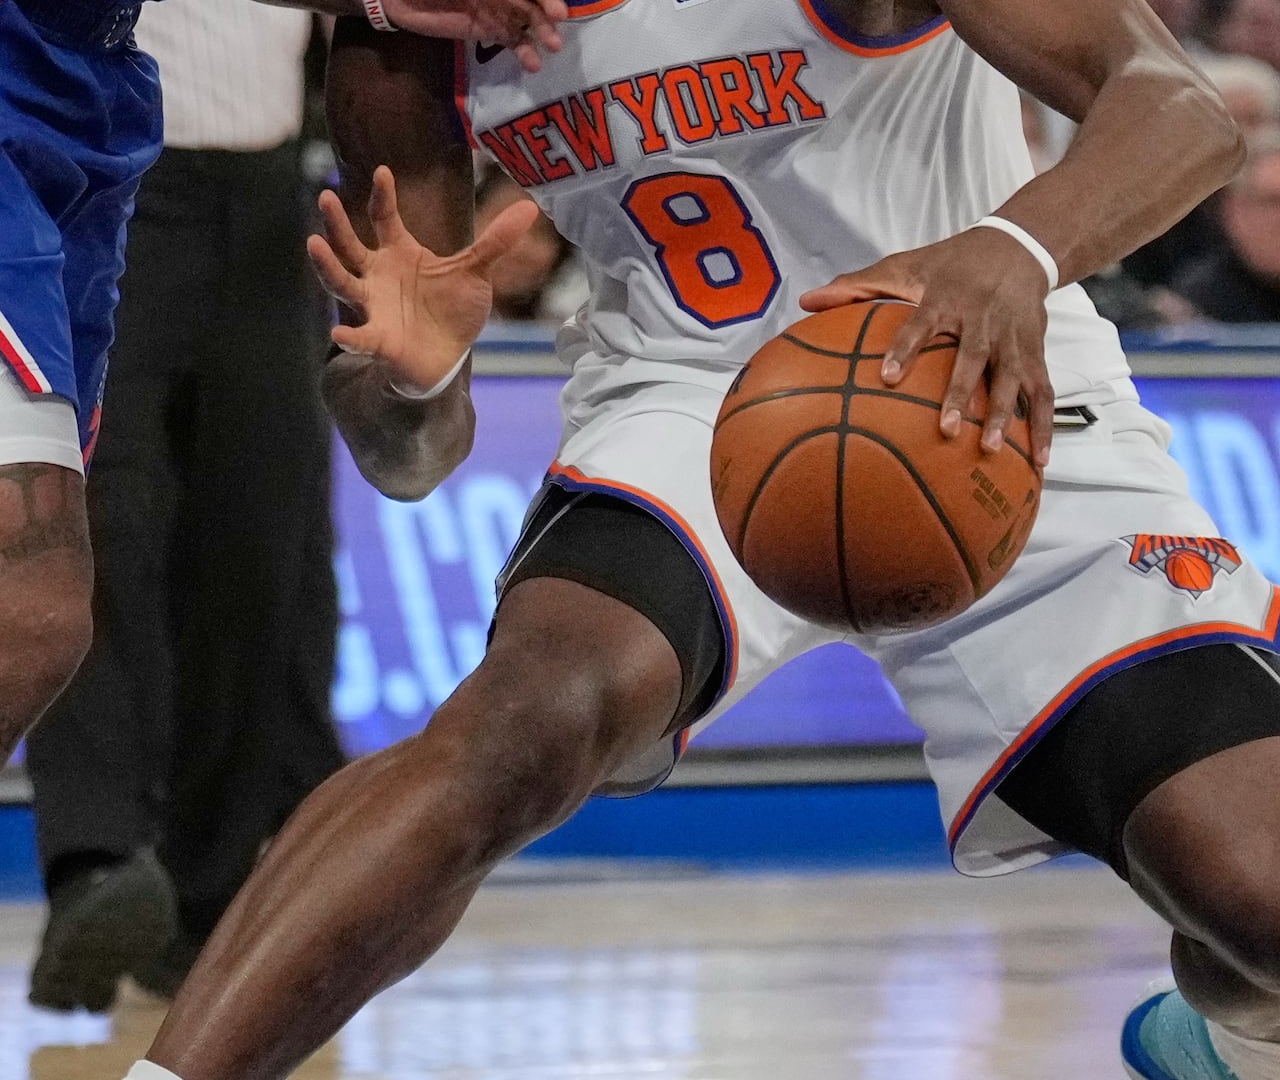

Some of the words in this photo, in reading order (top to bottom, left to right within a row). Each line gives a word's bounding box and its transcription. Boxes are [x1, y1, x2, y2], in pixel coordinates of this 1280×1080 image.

[478, 87, 616, 188] NEW
[608, 49, 827, 156] YORK
[620, 171, 783, 330] 8
